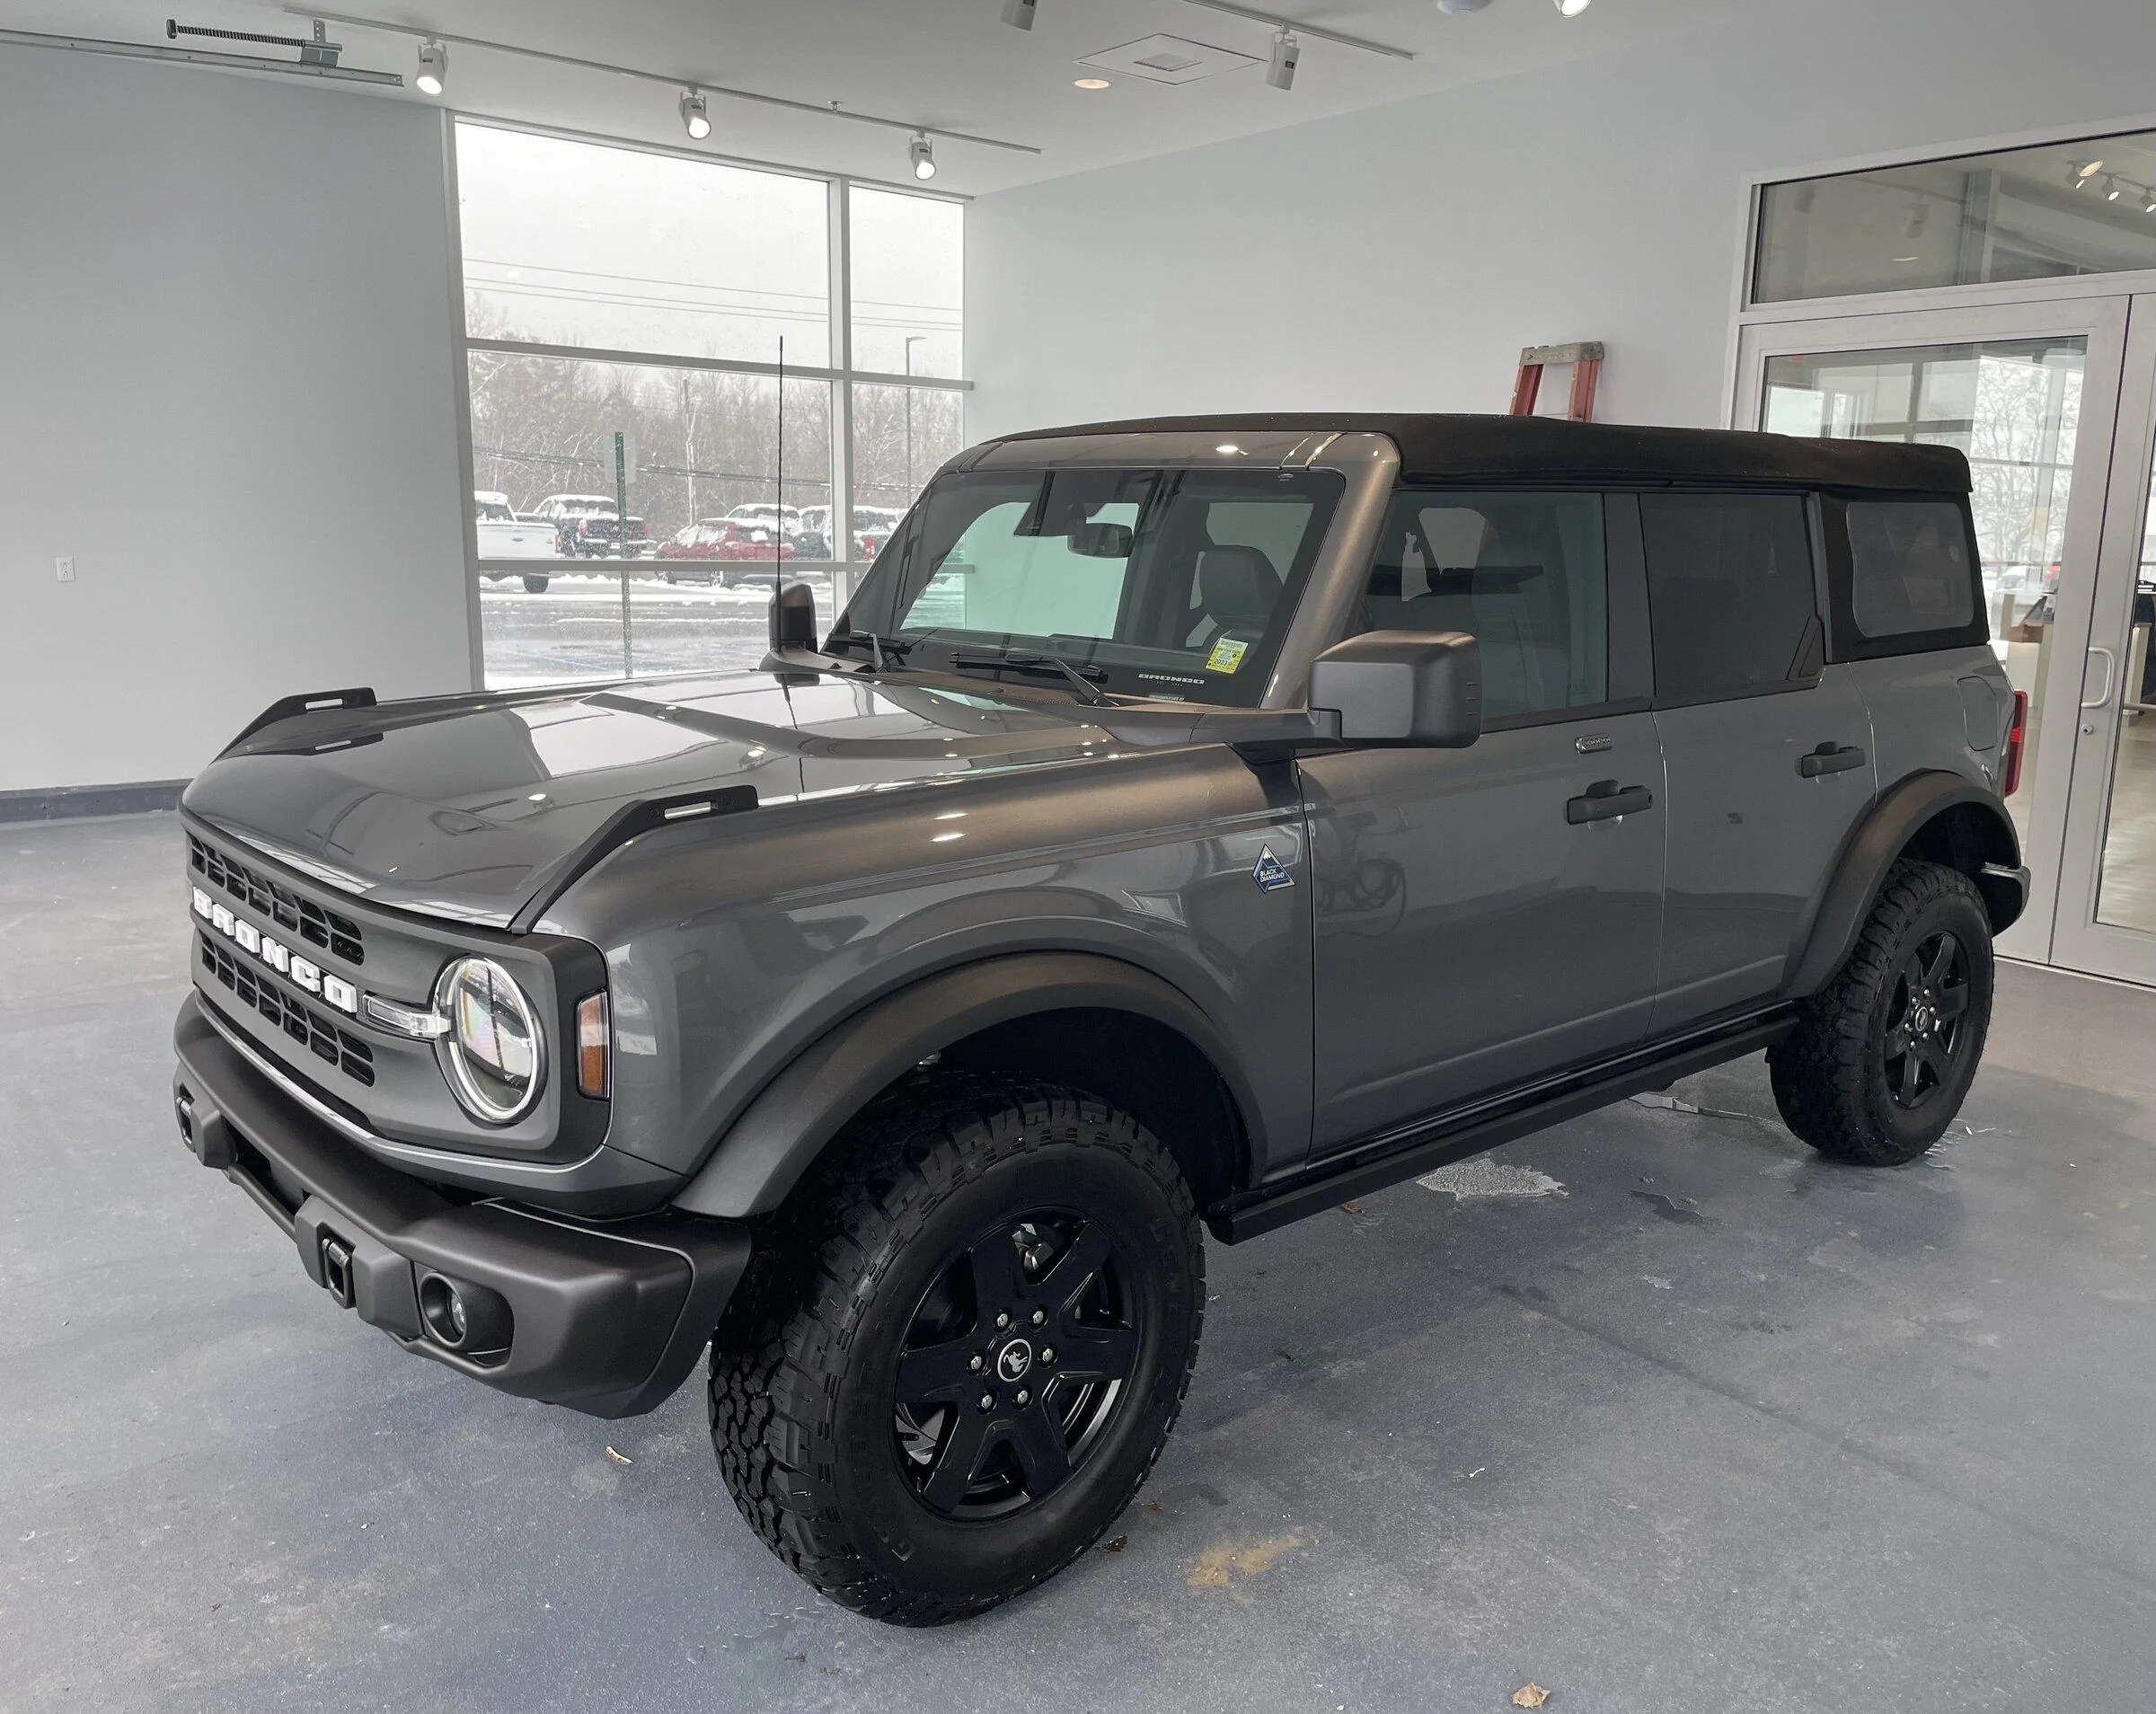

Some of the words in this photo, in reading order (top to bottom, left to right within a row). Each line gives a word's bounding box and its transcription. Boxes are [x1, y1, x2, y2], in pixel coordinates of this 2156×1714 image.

[1215, 658, 1227, 666] 2023
[1138, 673, 1205, 685] BRONCO
[1259, 868, 1277, 877] BLACK
[1260, 872, 1285, 882] DIAMOND
[193, 887, 358, 1013] BRONCO
